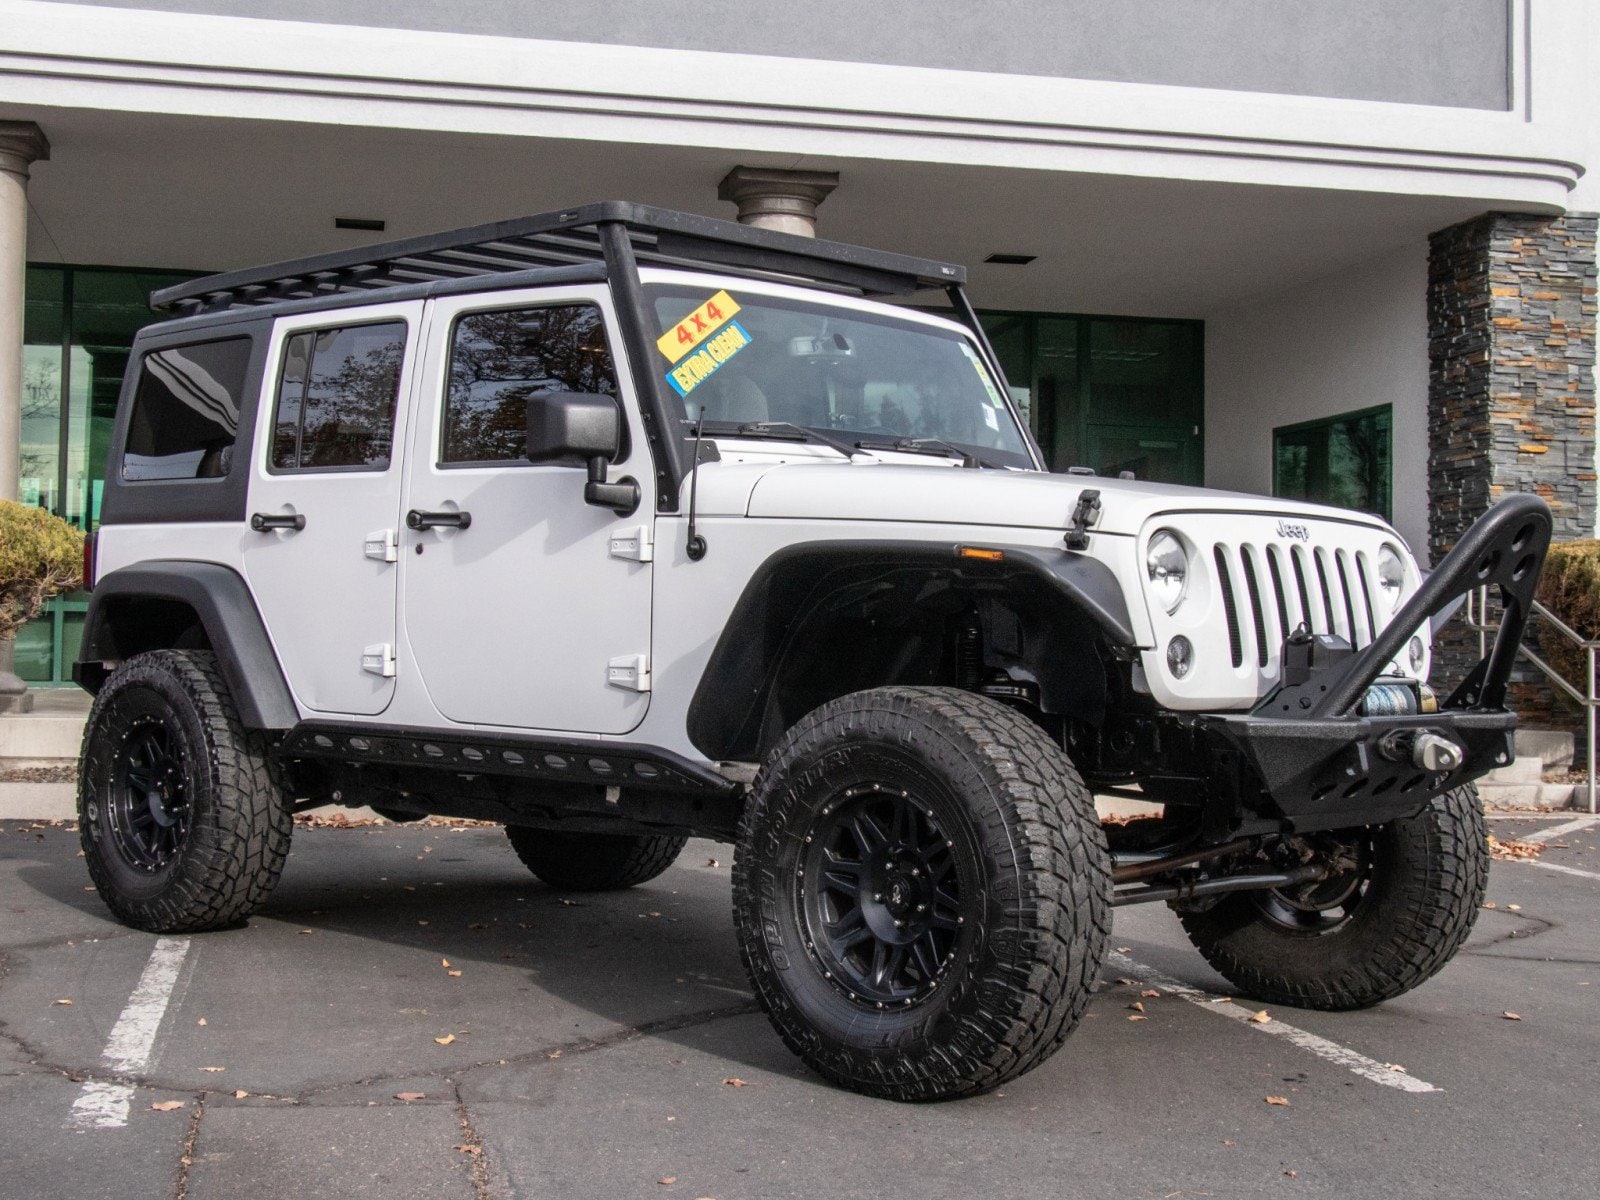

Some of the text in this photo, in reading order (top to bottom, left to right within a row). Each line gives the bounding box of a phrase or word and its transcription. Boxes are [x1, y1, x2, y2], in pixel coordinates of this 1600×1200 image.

[672, 324, 747, 392] EXTRA CLEAN
[1276, 520, 1310, 543] Jeep
